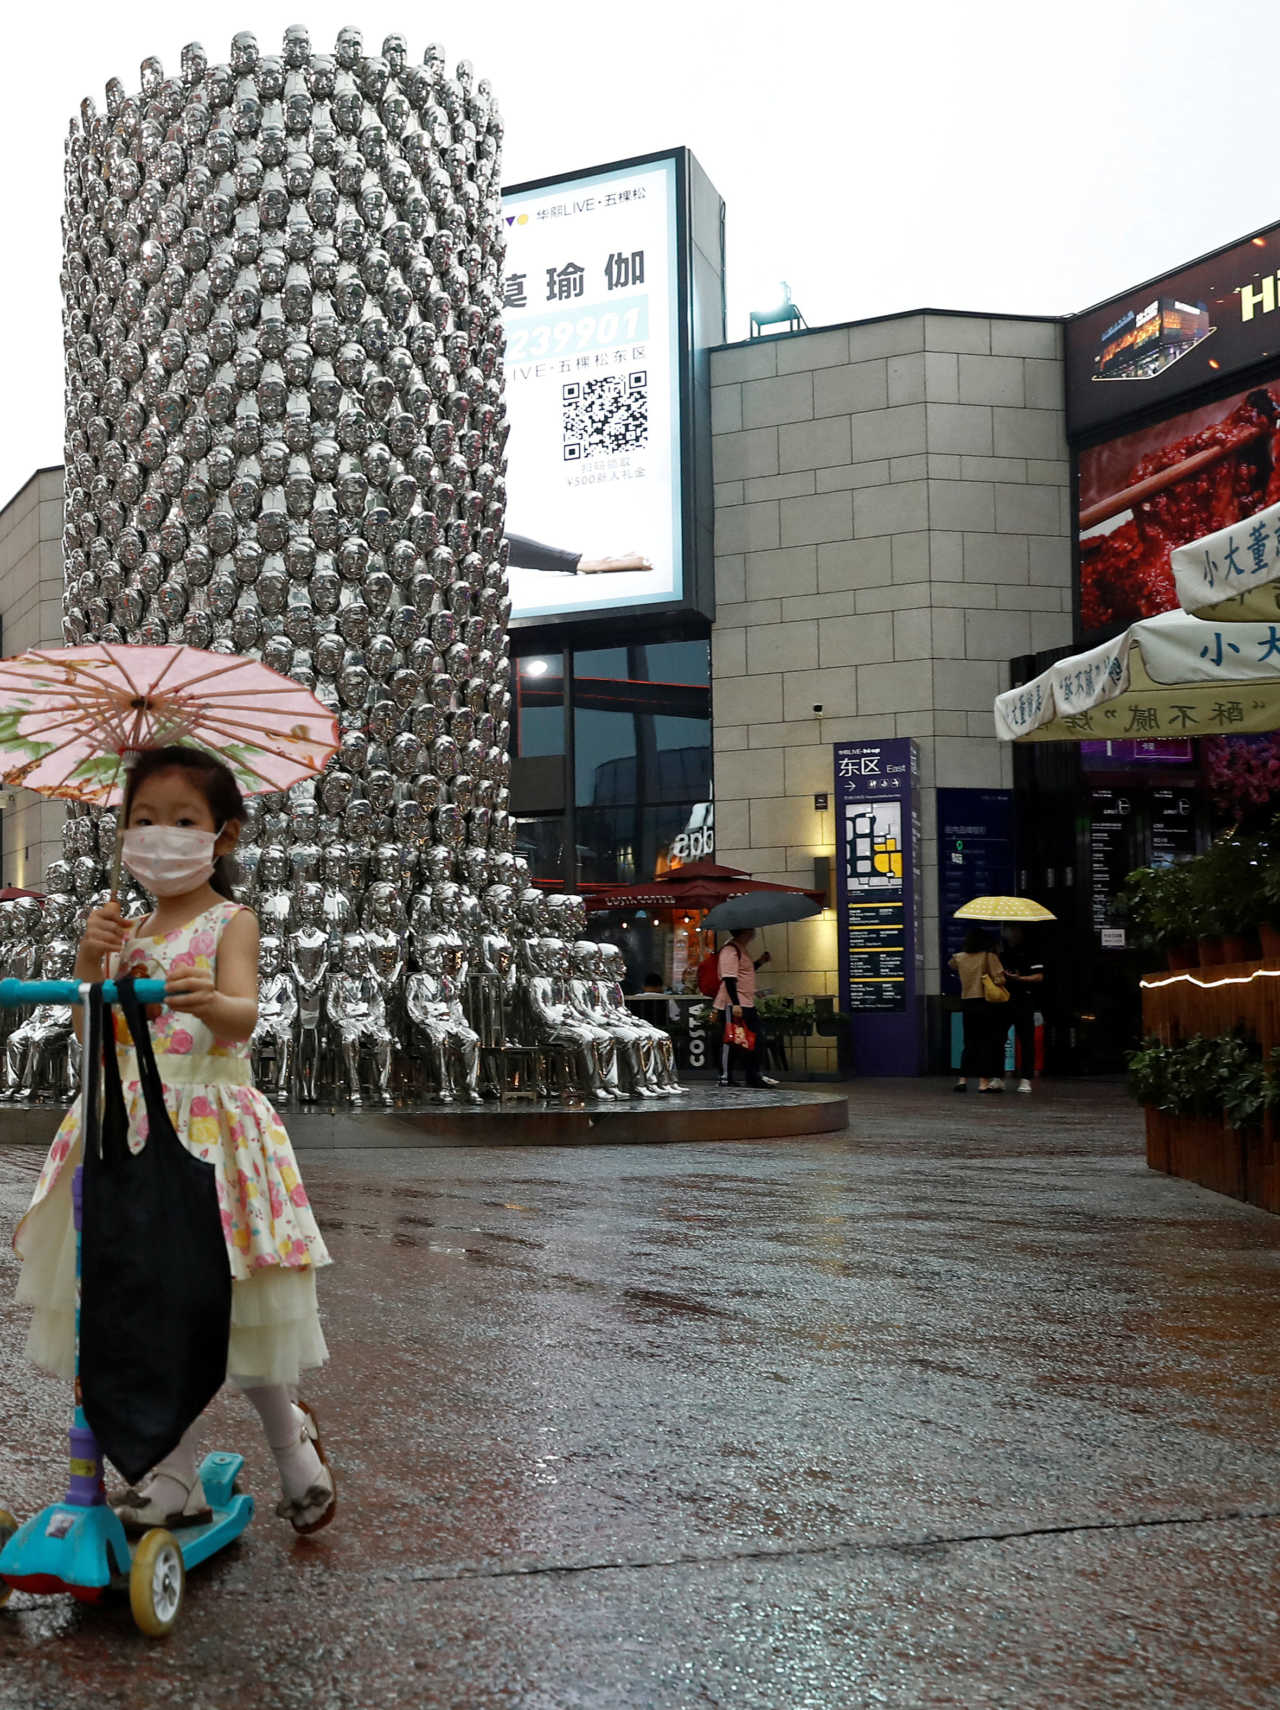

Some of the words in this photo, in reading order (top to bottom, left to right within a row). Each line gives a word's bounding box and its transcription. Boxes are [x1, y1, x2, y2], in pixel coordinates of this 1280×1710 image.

[1240, 268, 1280, 323] H
[838, 757, 881, 777] 东区
[886, 764, 907, 773] East
[688, 1003, 706, 1067] COSTA
